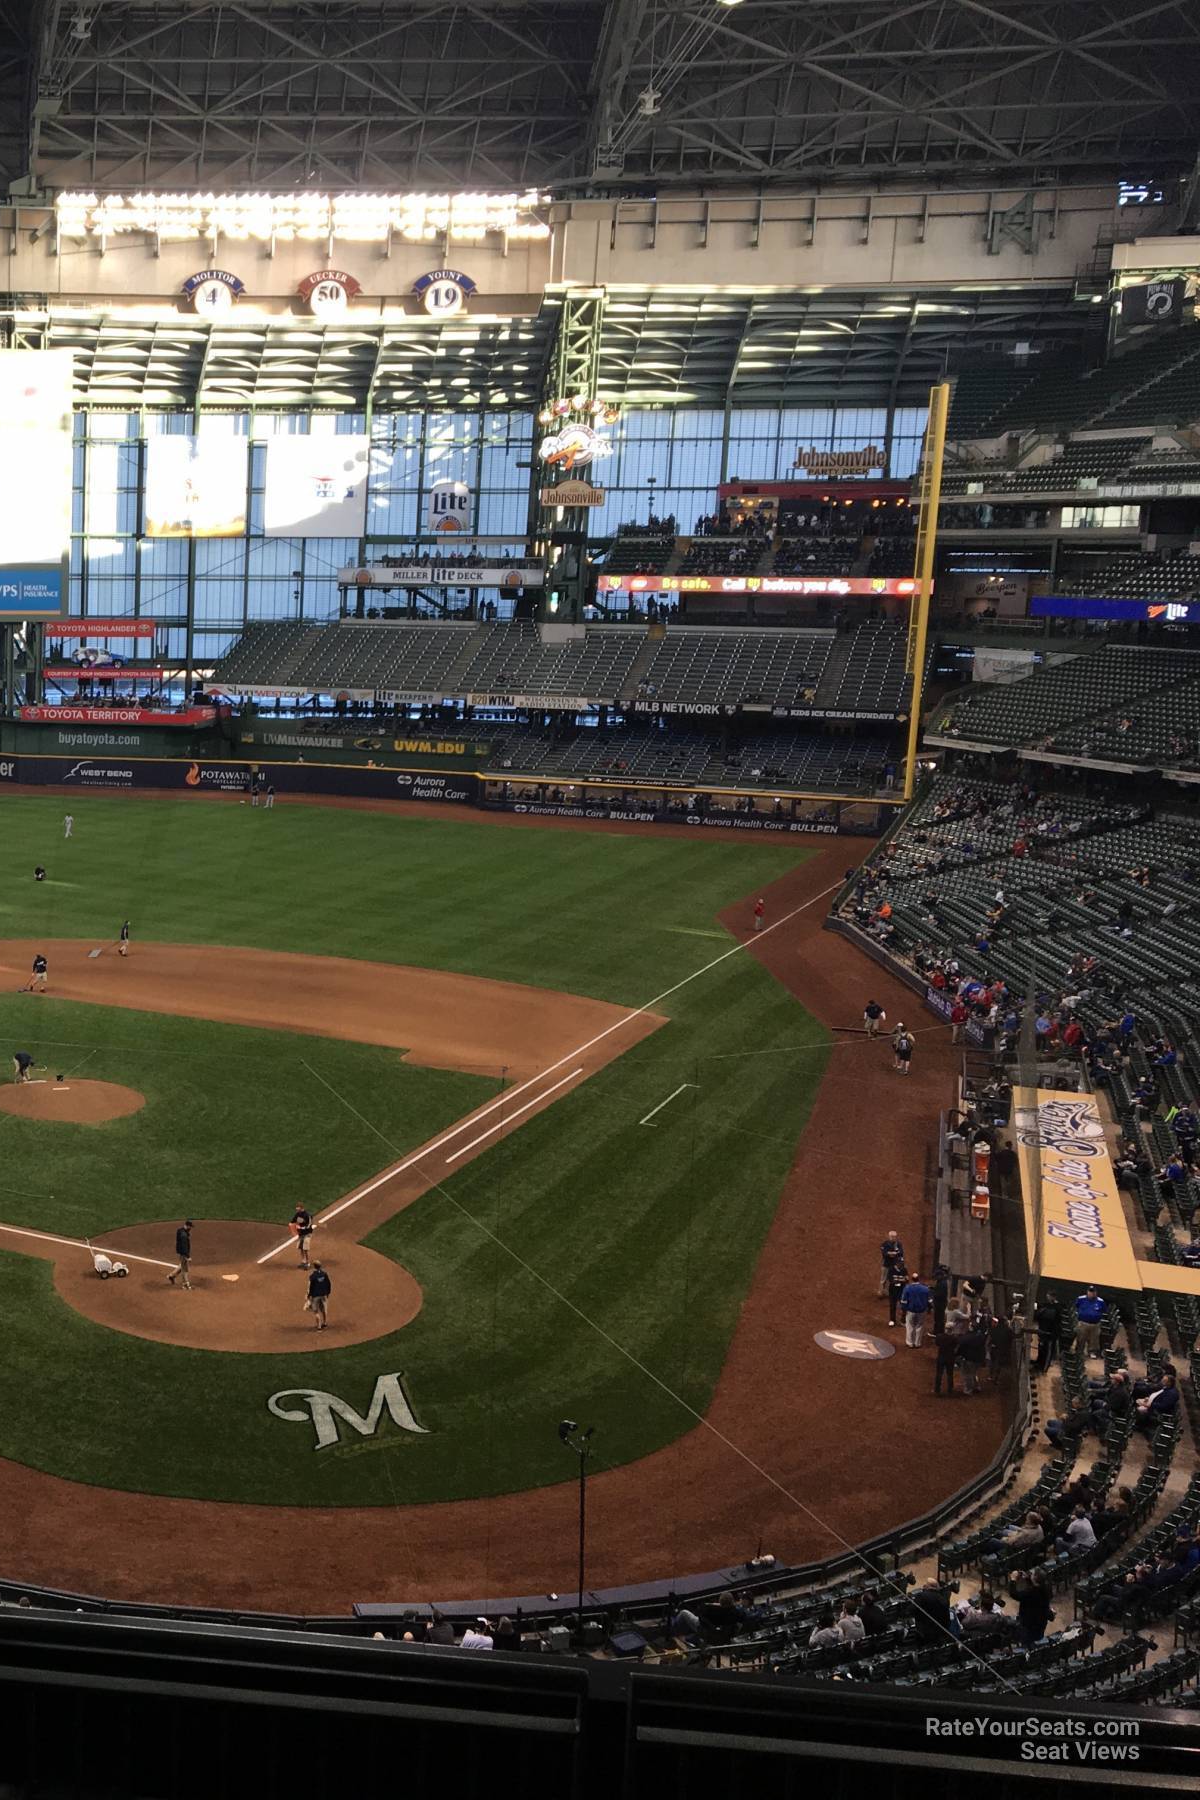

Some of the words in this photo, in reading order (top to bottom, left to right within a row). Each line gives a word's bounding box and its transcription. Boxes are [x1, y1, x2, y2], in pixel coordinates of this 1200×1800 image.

[192, 271, 235, 286] MOLITOR
[310, 271, 347, 284] UECKER
[427, 271, 461, 282] YOUNT
[205, 287, 217, 306] 4
[318, 285, 340, 301] 50
[430, 287, 458, 308] 19
[793, 446, 887, 468] Johnsonville
[433, 492, 467, 515] Lite
[544, 491, 602, 504] Johnsonville
[457, 572, 483, 580] DECK
[722, 577, 746, 589] Call
[763, 578, 801, 590] before
[803, 582, 825, 594] you
[1167, 603, 1189, 620] Lite
[489, 695, 514, 706] WTMJ
[43, 709, 83, 719] TOYOTA
[86, 709, 141, 721] TERRITORY
[634, 701, 659, 713] MLB
[662, 702, 719, 716] NETWORK
[791, 709, 810, 717] KIDS
[826, 711, 854, 719] CREAM
[856, 712, 894, 720] SUNDAYS
[58, 731, 140, 746] buyatoyota.com
[394, 740, 465, 754] UWM.EDU
[80, 769, 106, 777] WEST
[107, 770, 133, 778] BEND
[413, 775, 446, 787] Aurora
[412, 787, 443, 798] Health
[445, 789, 468, 800] Care
[529, 806, 556, 815] Aurora
[558, 807, 584, 817] Health
[586, 809, 604, 818] Care
[609, 811, 654, 821] BULLPEN
[702, 817, 732, 828] Aurora
[734, 817, 761, 828] Health
[763, 820, 784, 830] Care
[790, 823, 838, 833] BULLPEN
[1048, 1200, 1106, 1249] Home
